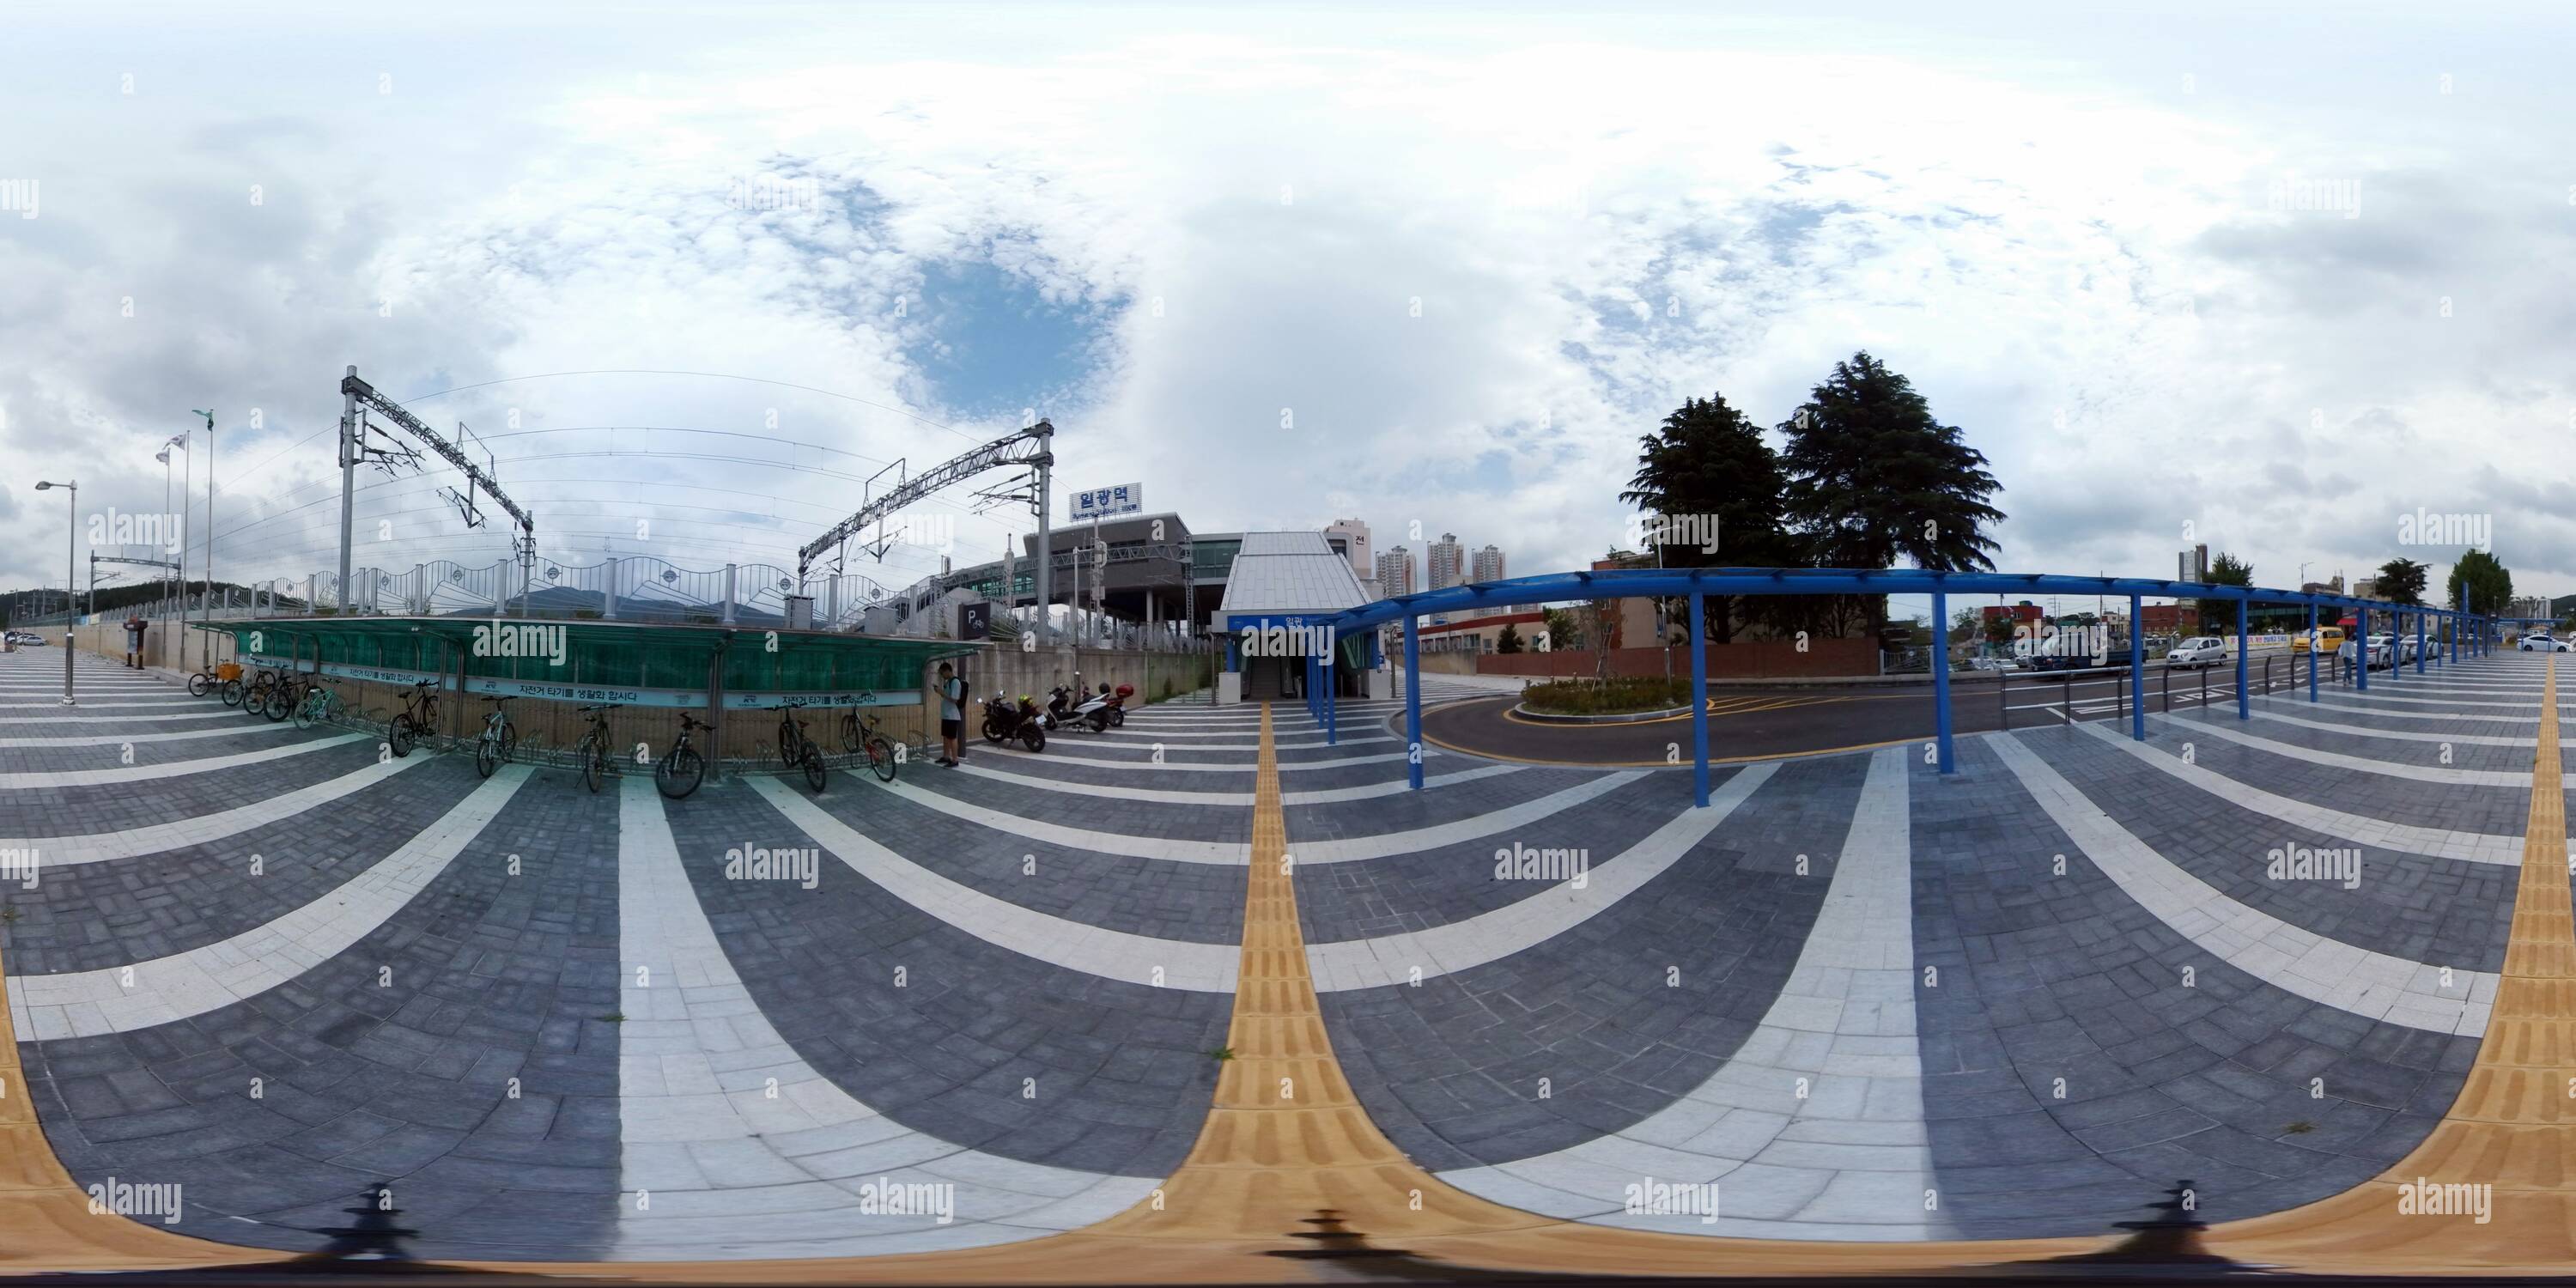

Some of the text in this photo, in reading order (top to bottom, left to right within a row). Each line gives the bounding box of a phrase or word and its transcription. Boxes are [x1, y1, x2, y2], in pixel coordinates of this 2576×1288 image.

[1080, 486, 1127, 508] 일광역
[969, 611, 975, 623] P
[519, 684, 637, 702] 자전거 타기를 생활화 합시다
[808, 696, 830, 705] 타기를
